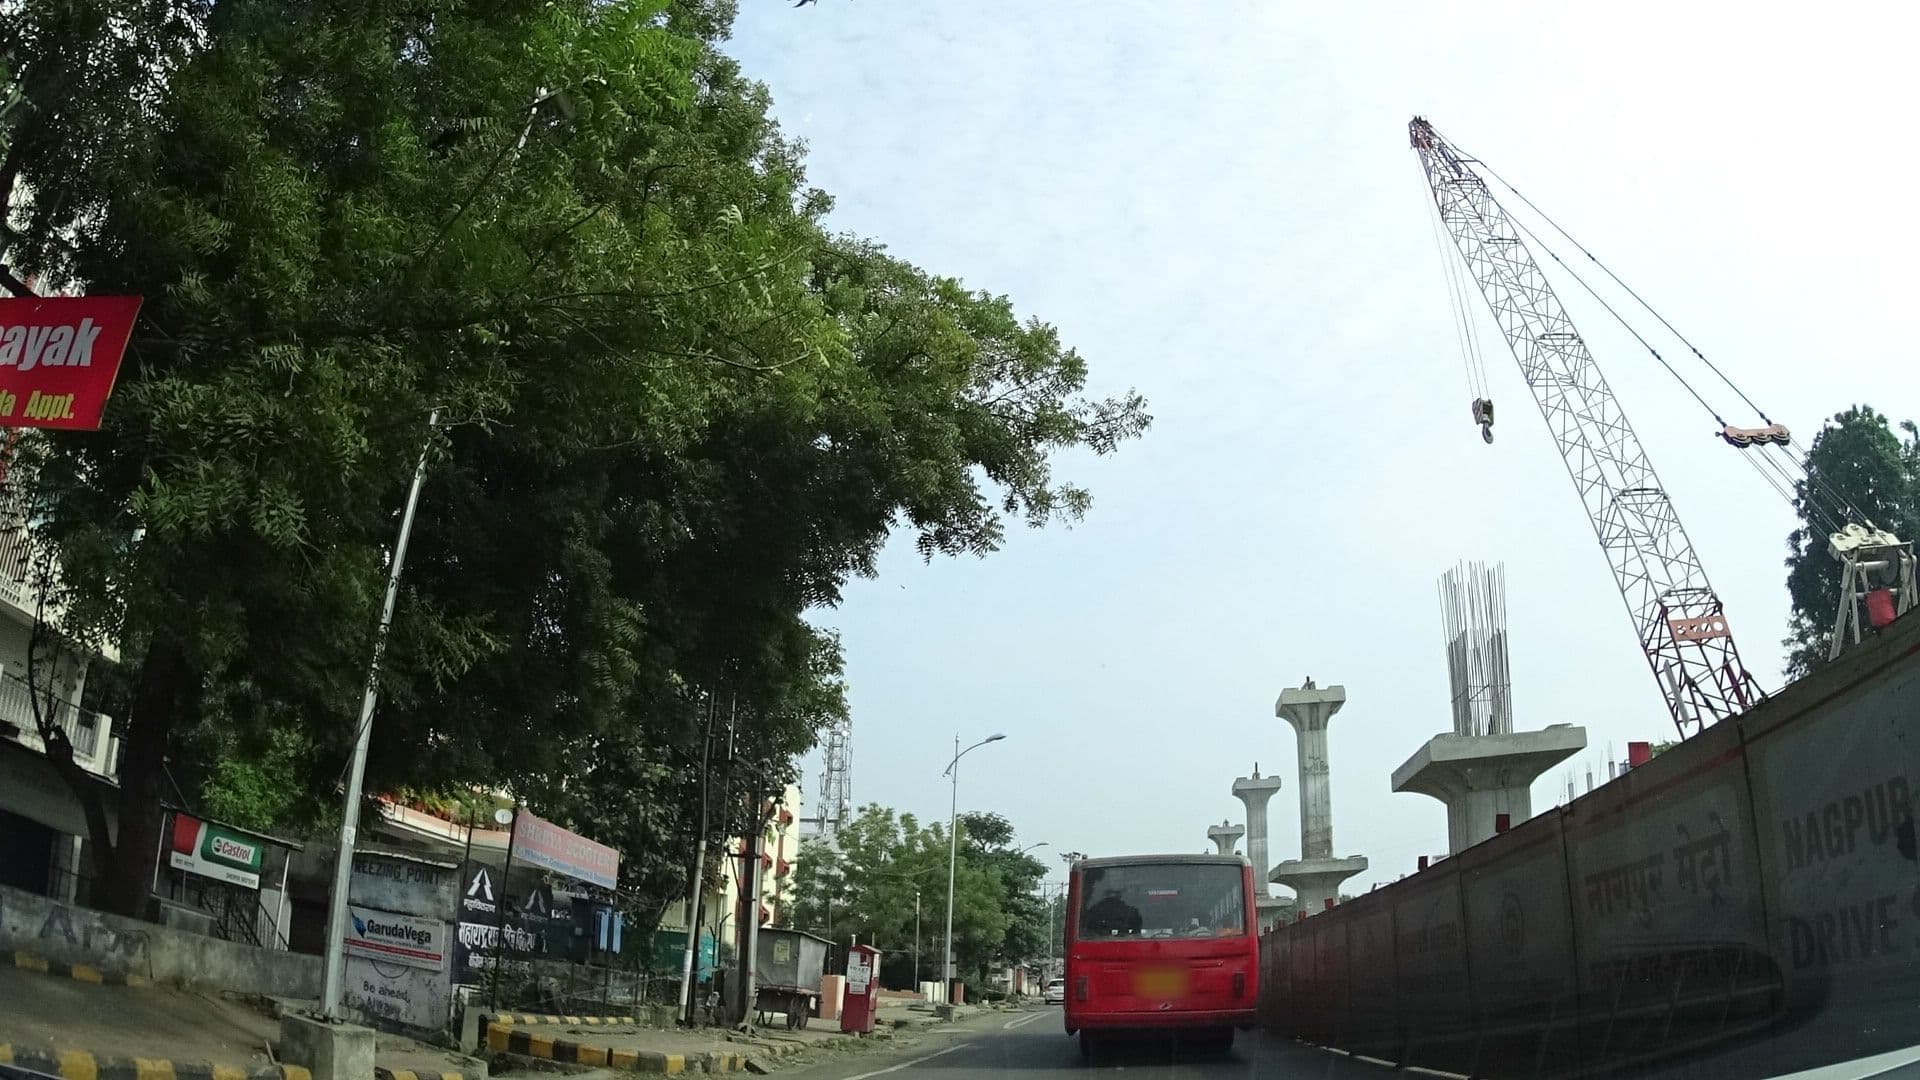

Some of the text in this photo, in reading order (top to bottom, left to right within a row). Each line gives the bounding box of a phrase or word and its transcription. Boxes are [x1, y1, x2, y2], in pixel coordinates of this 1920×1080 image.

[0, 317, 102, 372] ayak
[23, 390, 75, 421] Appt.
[222, 841, 251, 861] Castrol
[353, 861, 402, 881] REEZING
[367, 919, 432, 945] GarudaVega
